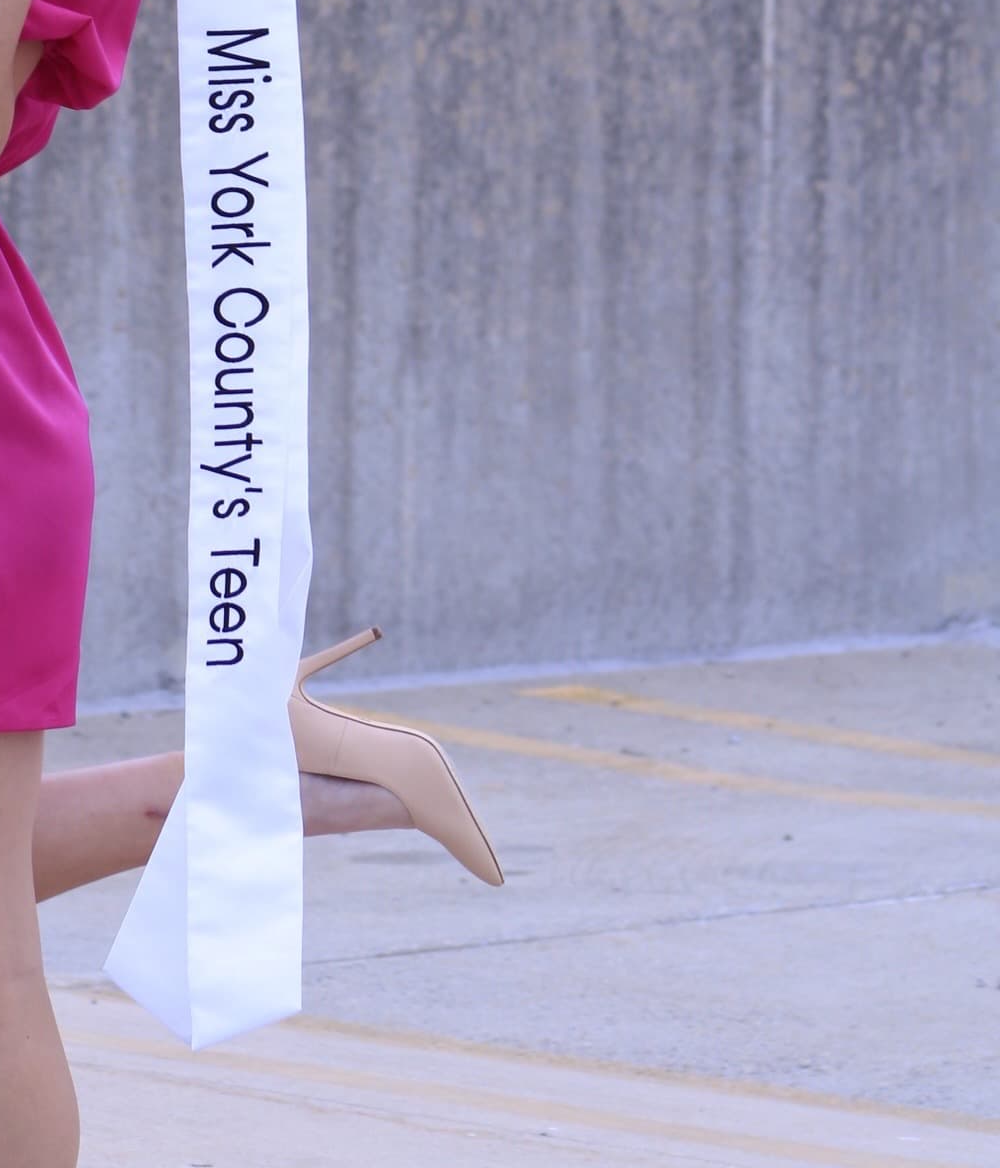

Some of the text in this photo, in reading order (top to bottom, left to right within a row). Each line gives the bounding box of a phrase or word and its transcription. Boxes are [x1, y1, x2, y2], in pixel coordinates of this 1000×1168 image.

[199, 27, 273, 667] Miss York County's Teen
